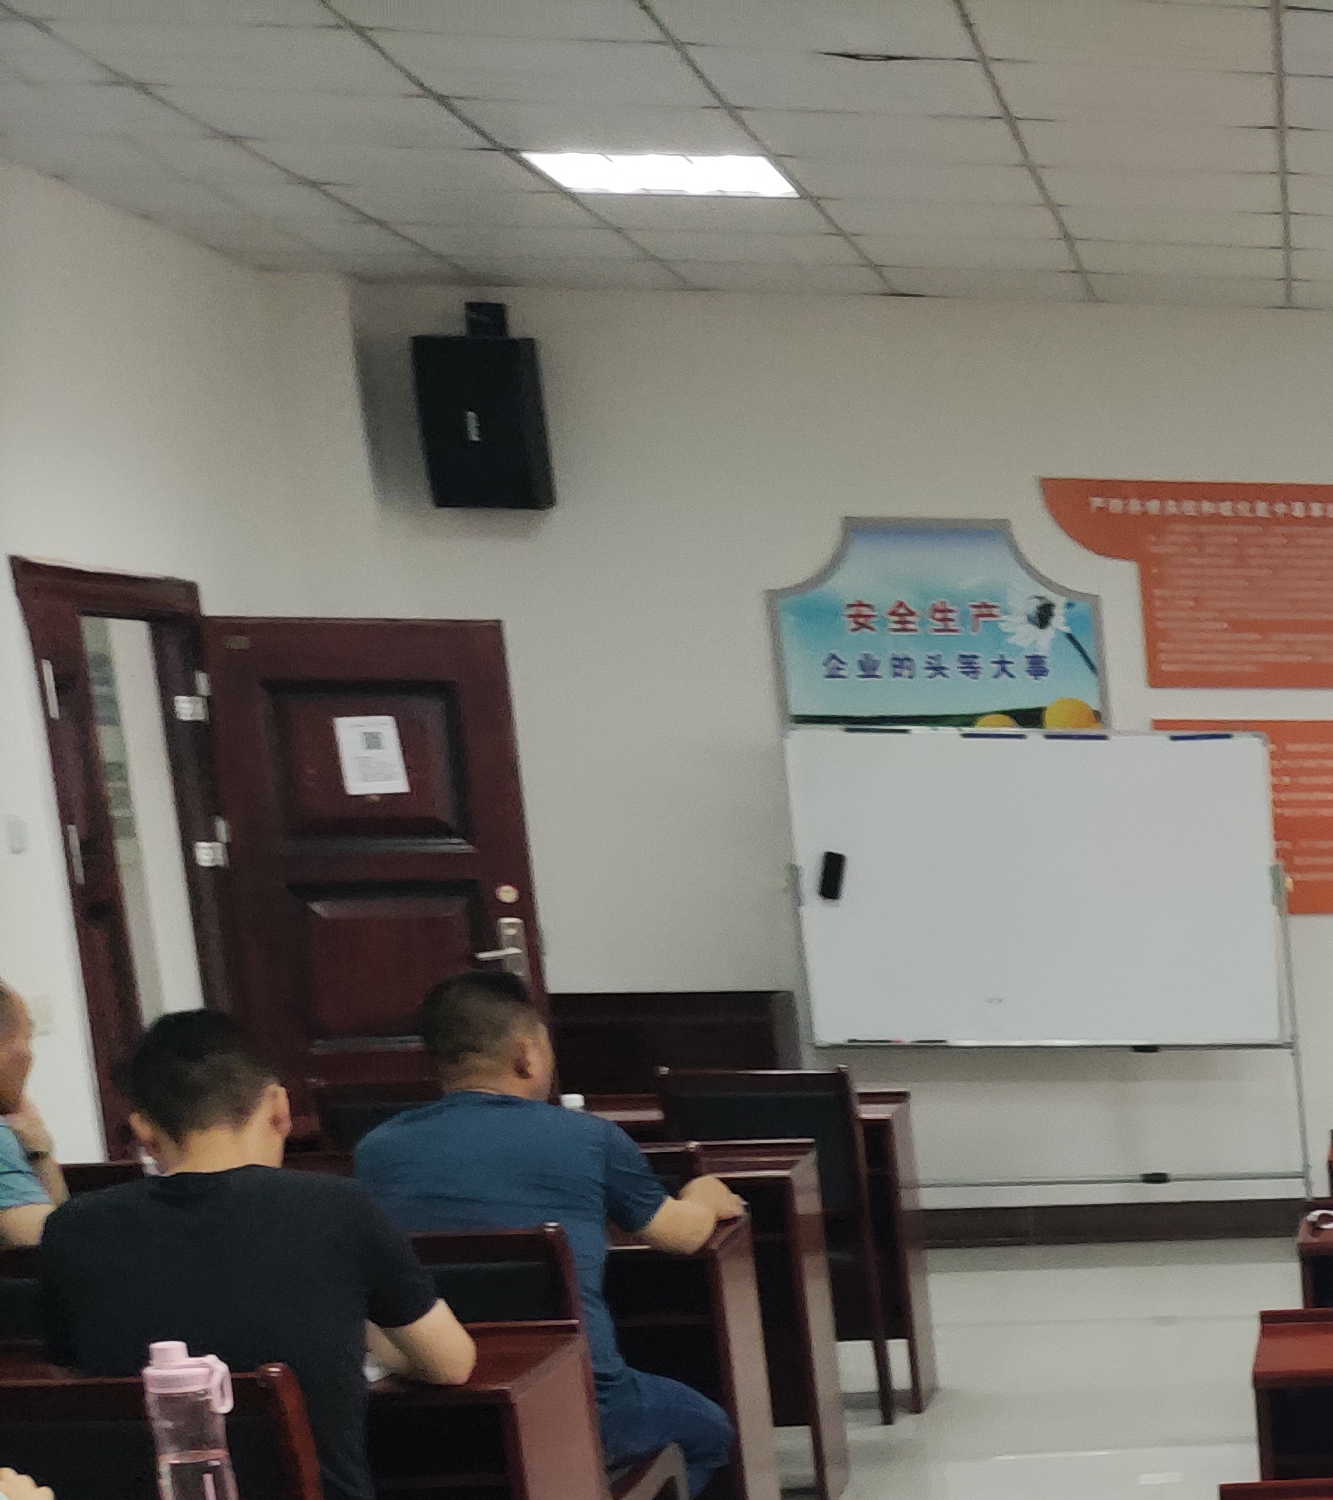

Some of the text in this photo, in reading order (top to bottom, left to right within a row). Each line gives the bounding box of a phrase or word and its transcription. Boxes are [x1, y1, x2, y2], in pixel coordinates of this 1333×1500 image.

[844, 600, 1000, 634] 安全生产
[822, 652, 1050, 680] 企业的头等大事
